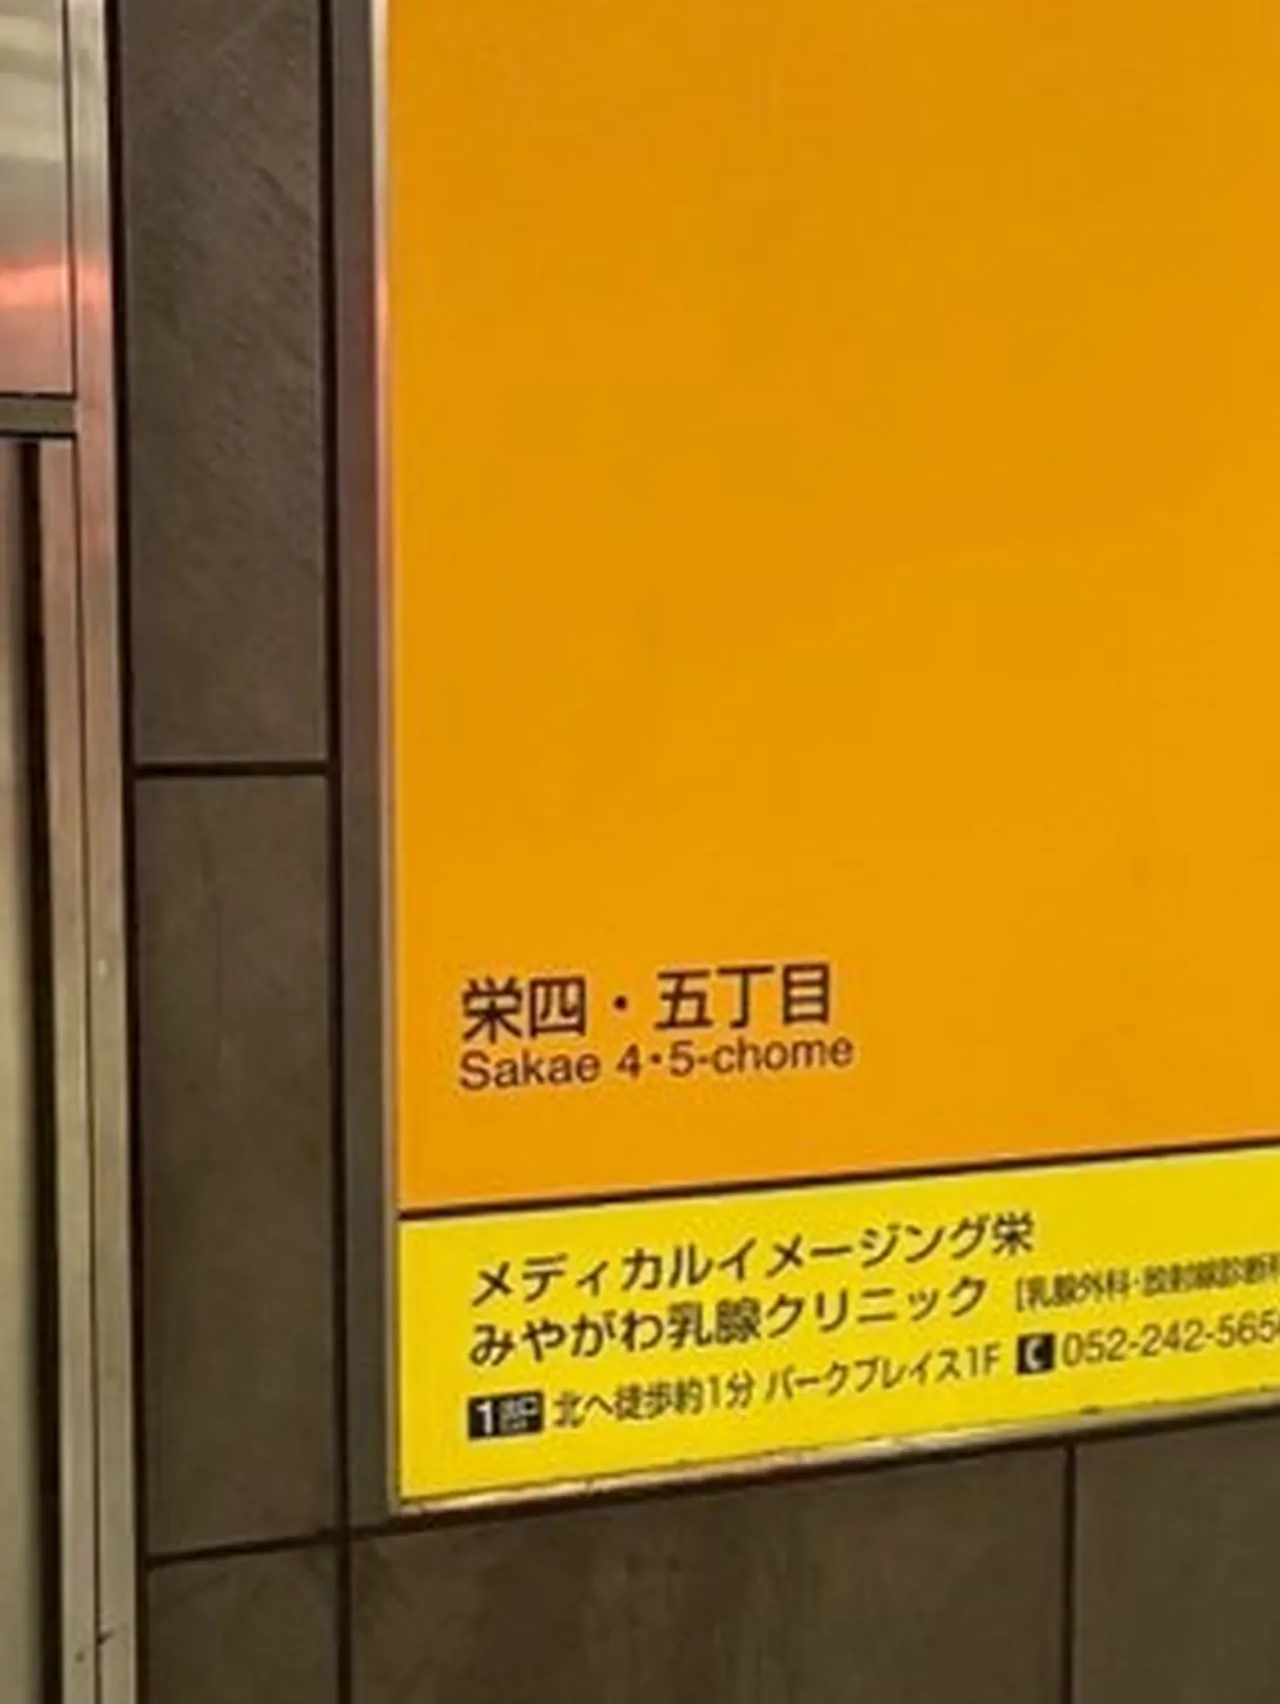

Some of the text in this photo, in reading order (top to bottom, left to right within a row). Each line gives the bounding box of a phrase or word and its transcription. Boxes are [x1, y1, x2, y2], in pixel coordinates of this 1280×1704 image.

[460, 961, 832, 1045] 栄四・五丁目
[459, 1048, 602, 1092] Sakae
[470, 1211, 1034, 1307] メディカルイメージング栄
[468, 1275, 988, 1368] みやがわ乳腺クリニック
